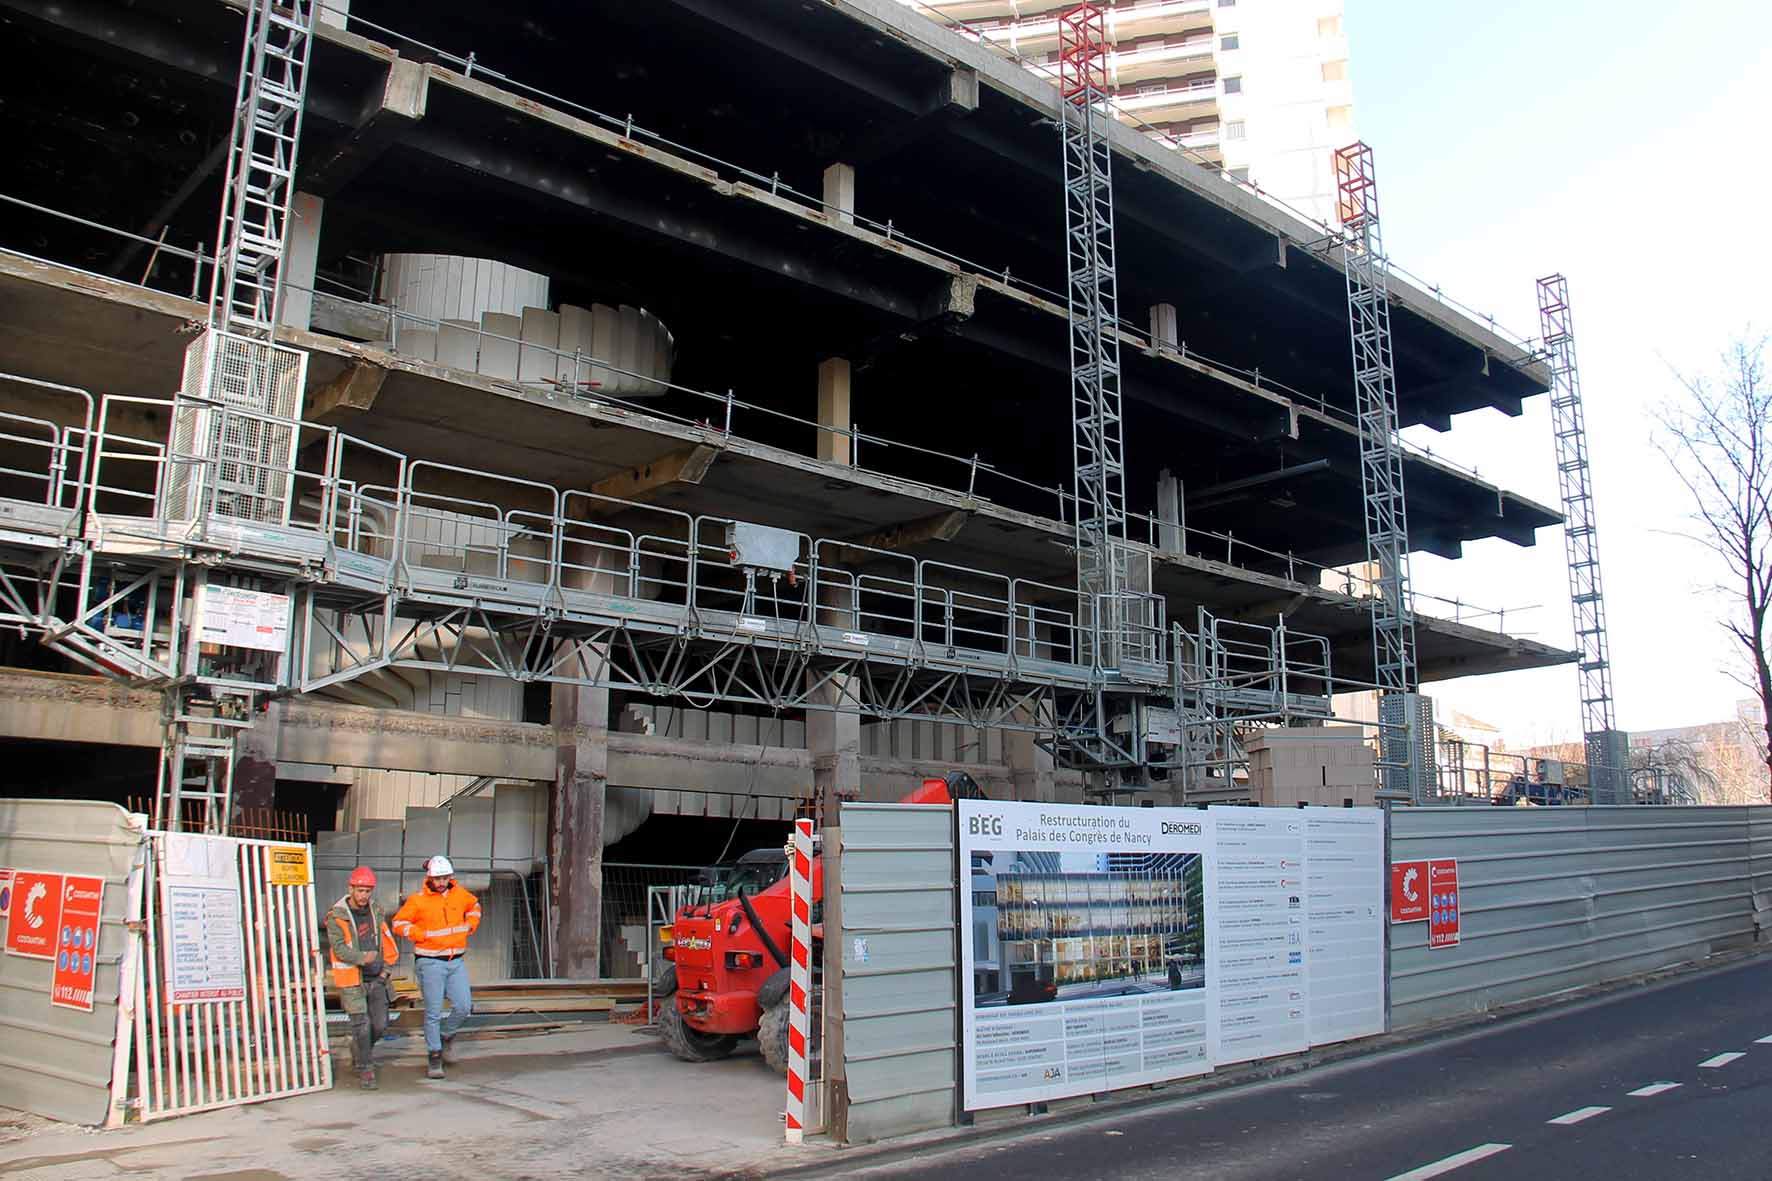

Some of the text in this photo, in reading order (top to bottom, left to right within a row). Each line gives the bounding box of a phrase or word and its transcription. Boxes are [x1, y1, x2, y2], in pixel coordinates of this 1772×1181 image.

[969, 816, 1002, 835] BEG
[1040, 813, 1130, 828] Restructuration du
[1016, 828, 1152, 846] Palais des Congrès de Nancy
